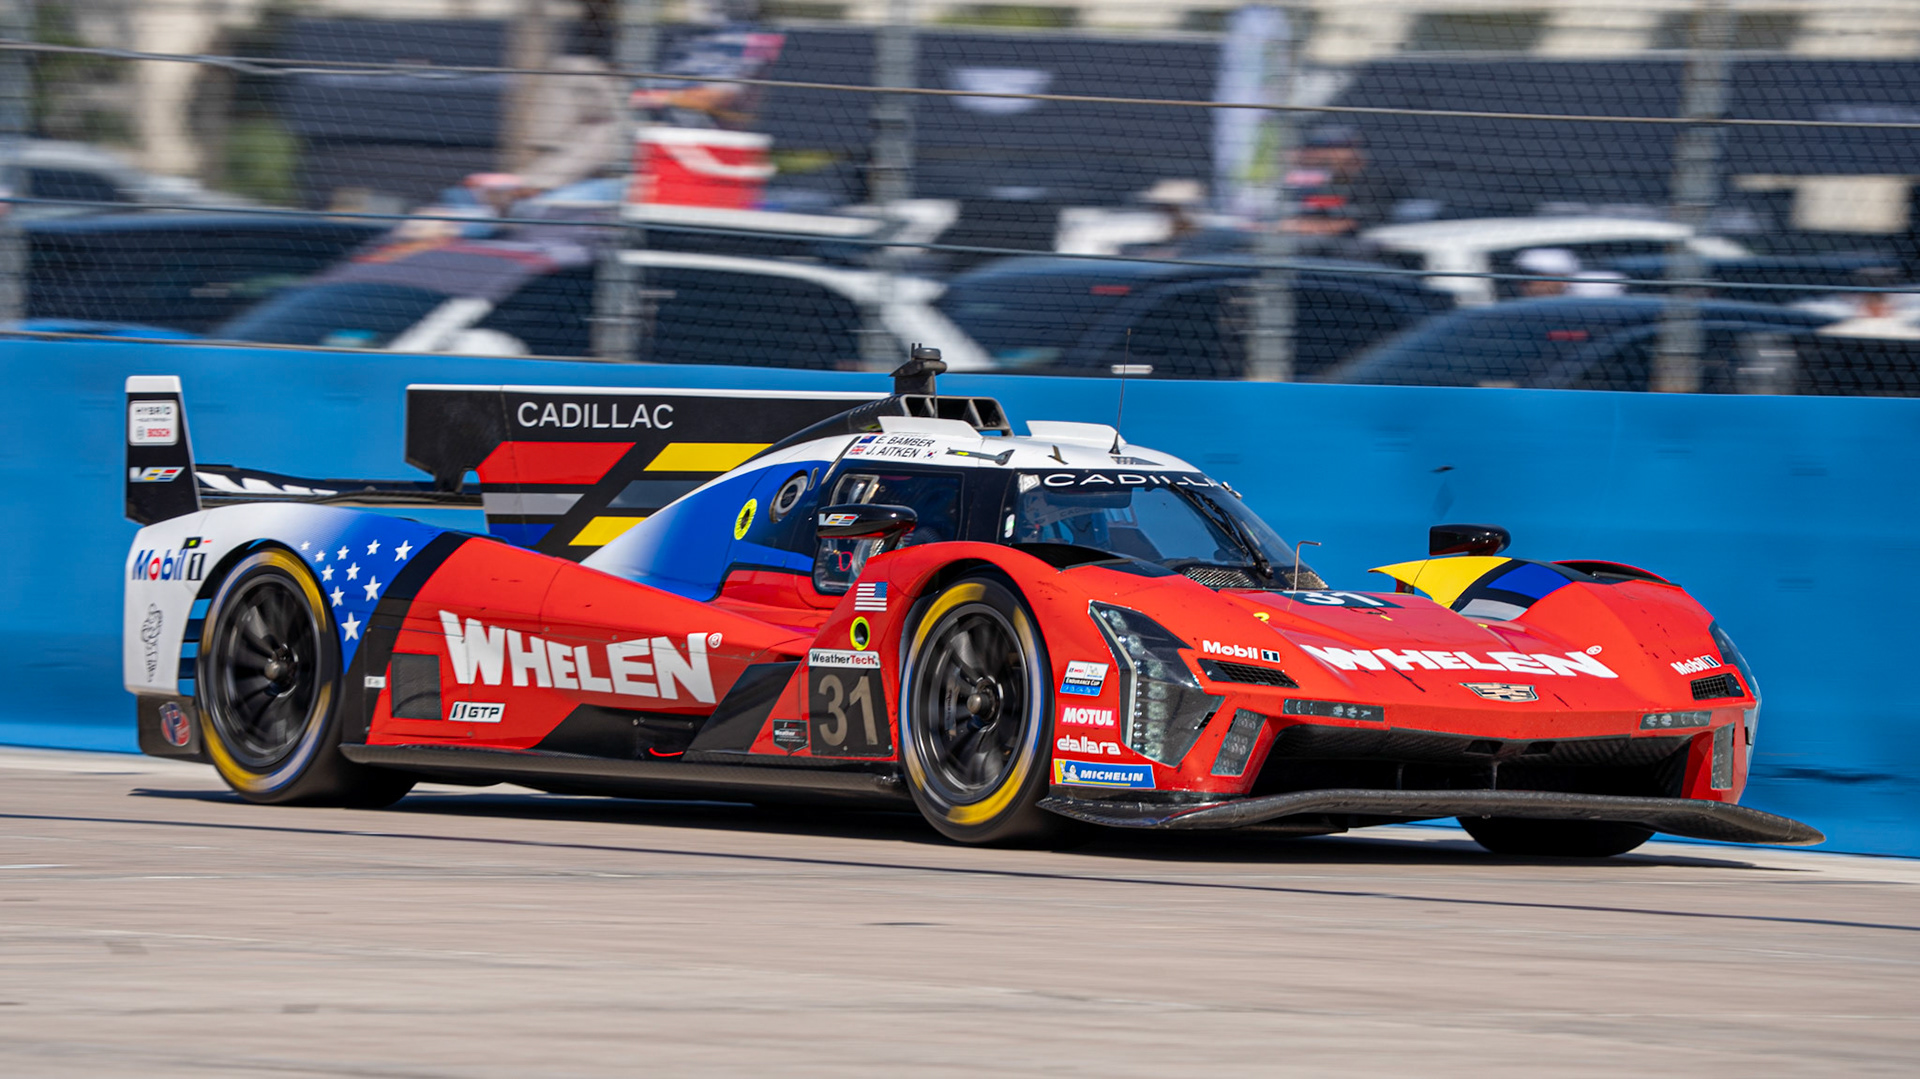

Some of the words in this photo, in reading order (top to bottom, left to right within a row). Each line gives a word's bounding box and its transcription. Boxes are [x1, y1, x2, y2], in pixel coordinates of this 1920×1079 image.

[517, 401, 674, 430] CADILLAC
[887, 436, 936, 447] BAMBER
[876, 446, 921, 458] AITKEN
[132, 549, 187, 581] Mobil
[438, 609, 717, 704] WHELEN
[812, 653, 876, 665] WeatherTech
[1203, 640, 1258, 660] Mobil
[1300, 645, 1619, 678] WHELEN
[1670, 657, 1710, 675] Mobil
[468, 706, 500, 719] GTP
[819, 674, 878, 747] 31
[1063, 707, 1114, 726] MOTUL
[1057, 734, 1121, 755] dallara
[1080, 769, 1143, 782] MICHELIN
